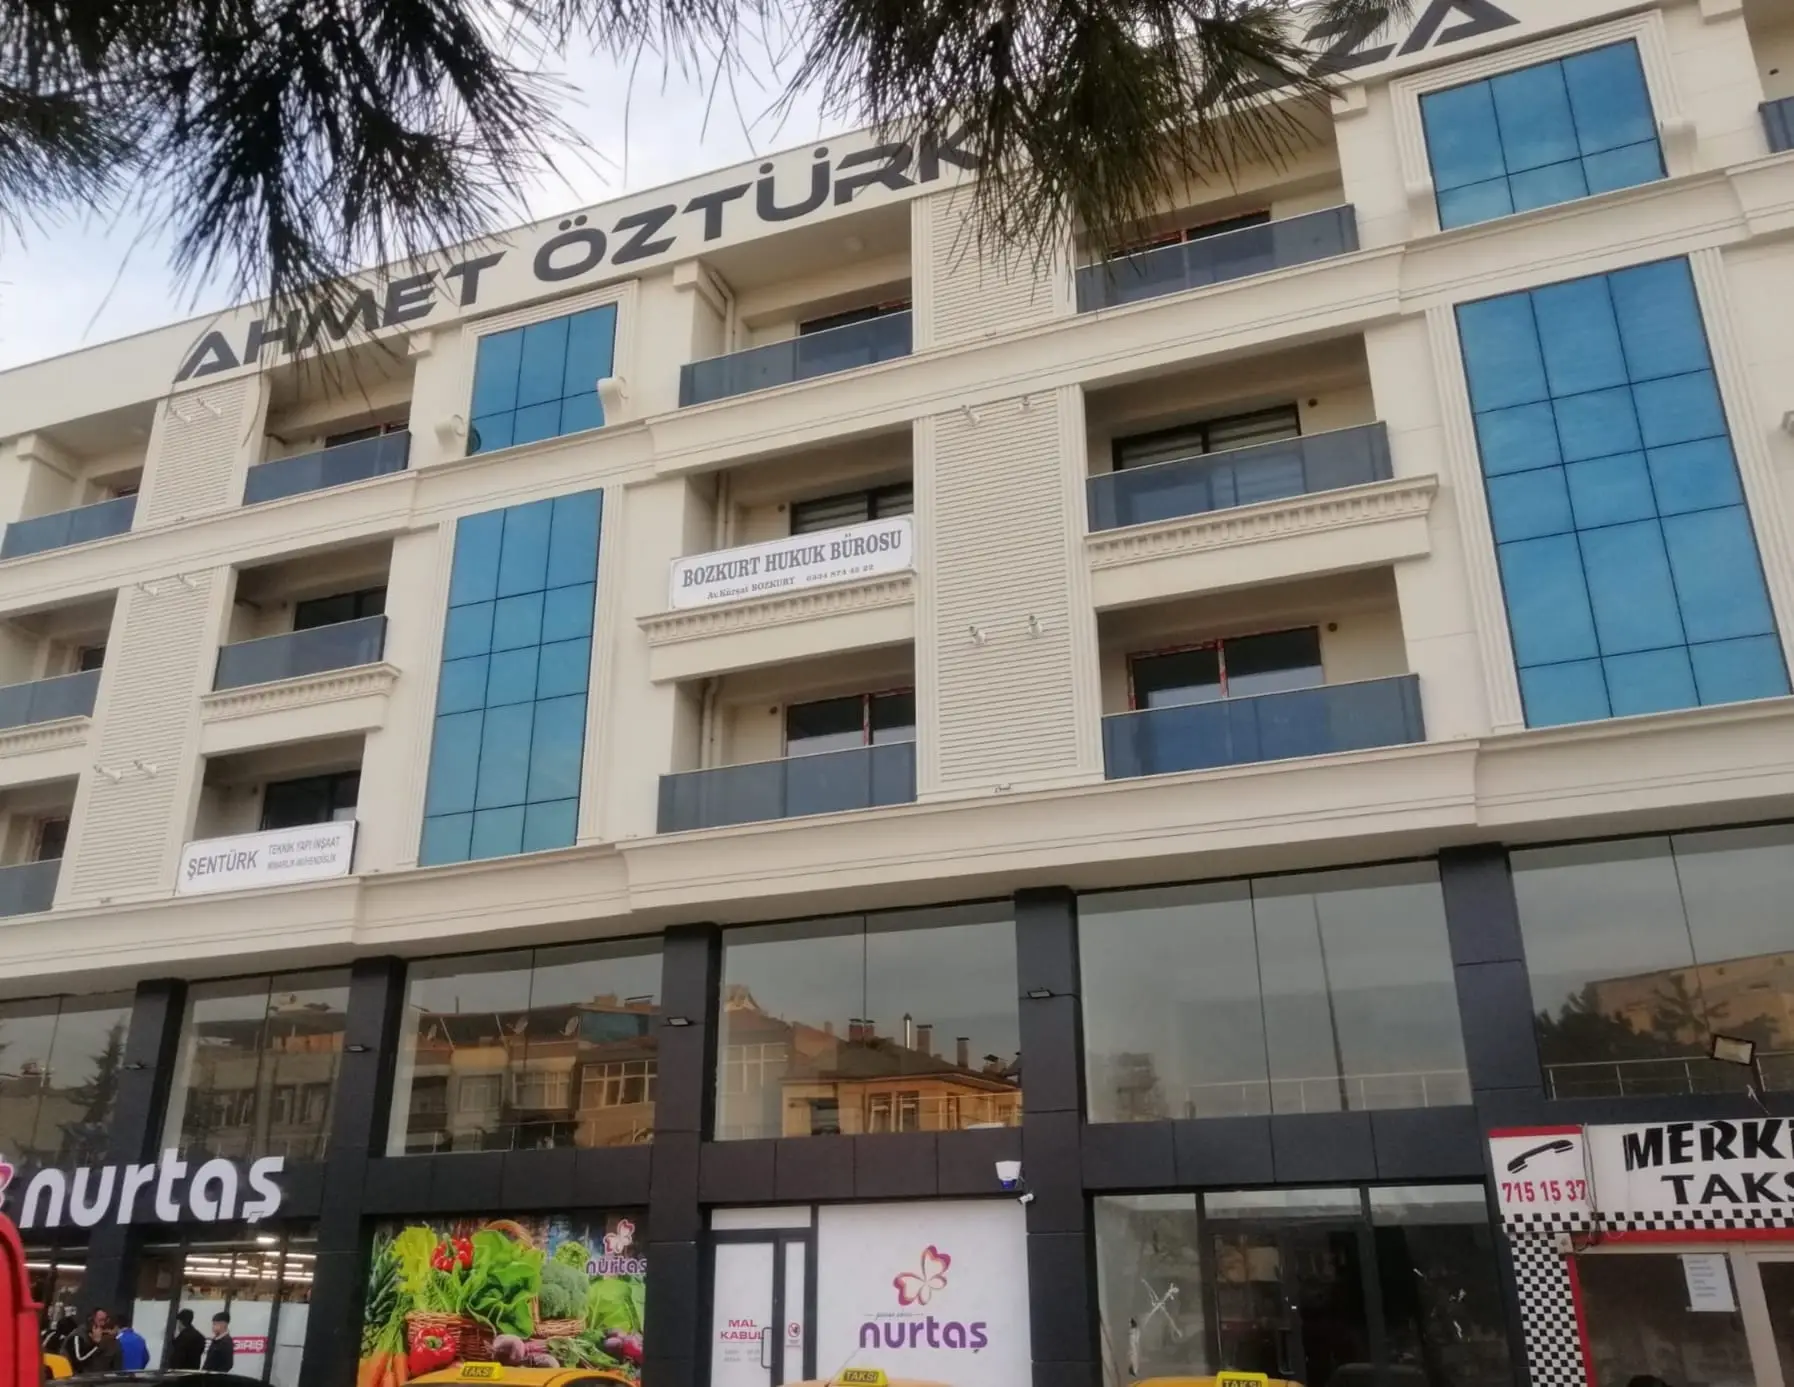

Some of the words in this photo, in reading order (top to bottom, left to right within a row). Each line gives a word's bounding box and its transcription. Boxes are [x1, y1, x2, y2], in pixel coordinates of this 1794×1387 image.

[172, 250, 508, 384] AHMET
[533, 118, 985, 282] ÖZTÜRK
[683, 556, 761, 588] BOZKURT
[764, 545, 826, 572] HUKUK
[830, 530, 903, 561] BÜROSU
[751, 577, 796, 592] BOZKURT
[186, 849, 261, 880] ŞENTÜRK
[19, 1148, 285, 1228] nurtaş
[1502, 1181, 1535, 1203] 715
[1540, 1180, 1561, 1202] 15
[1567, 1179, 1587, 1201] 37
[720, 1331, 764, 1340] KABUL
[728, 1319, 757, 1328] MAL
[859, 1315, 989, 1354] nurtaş
